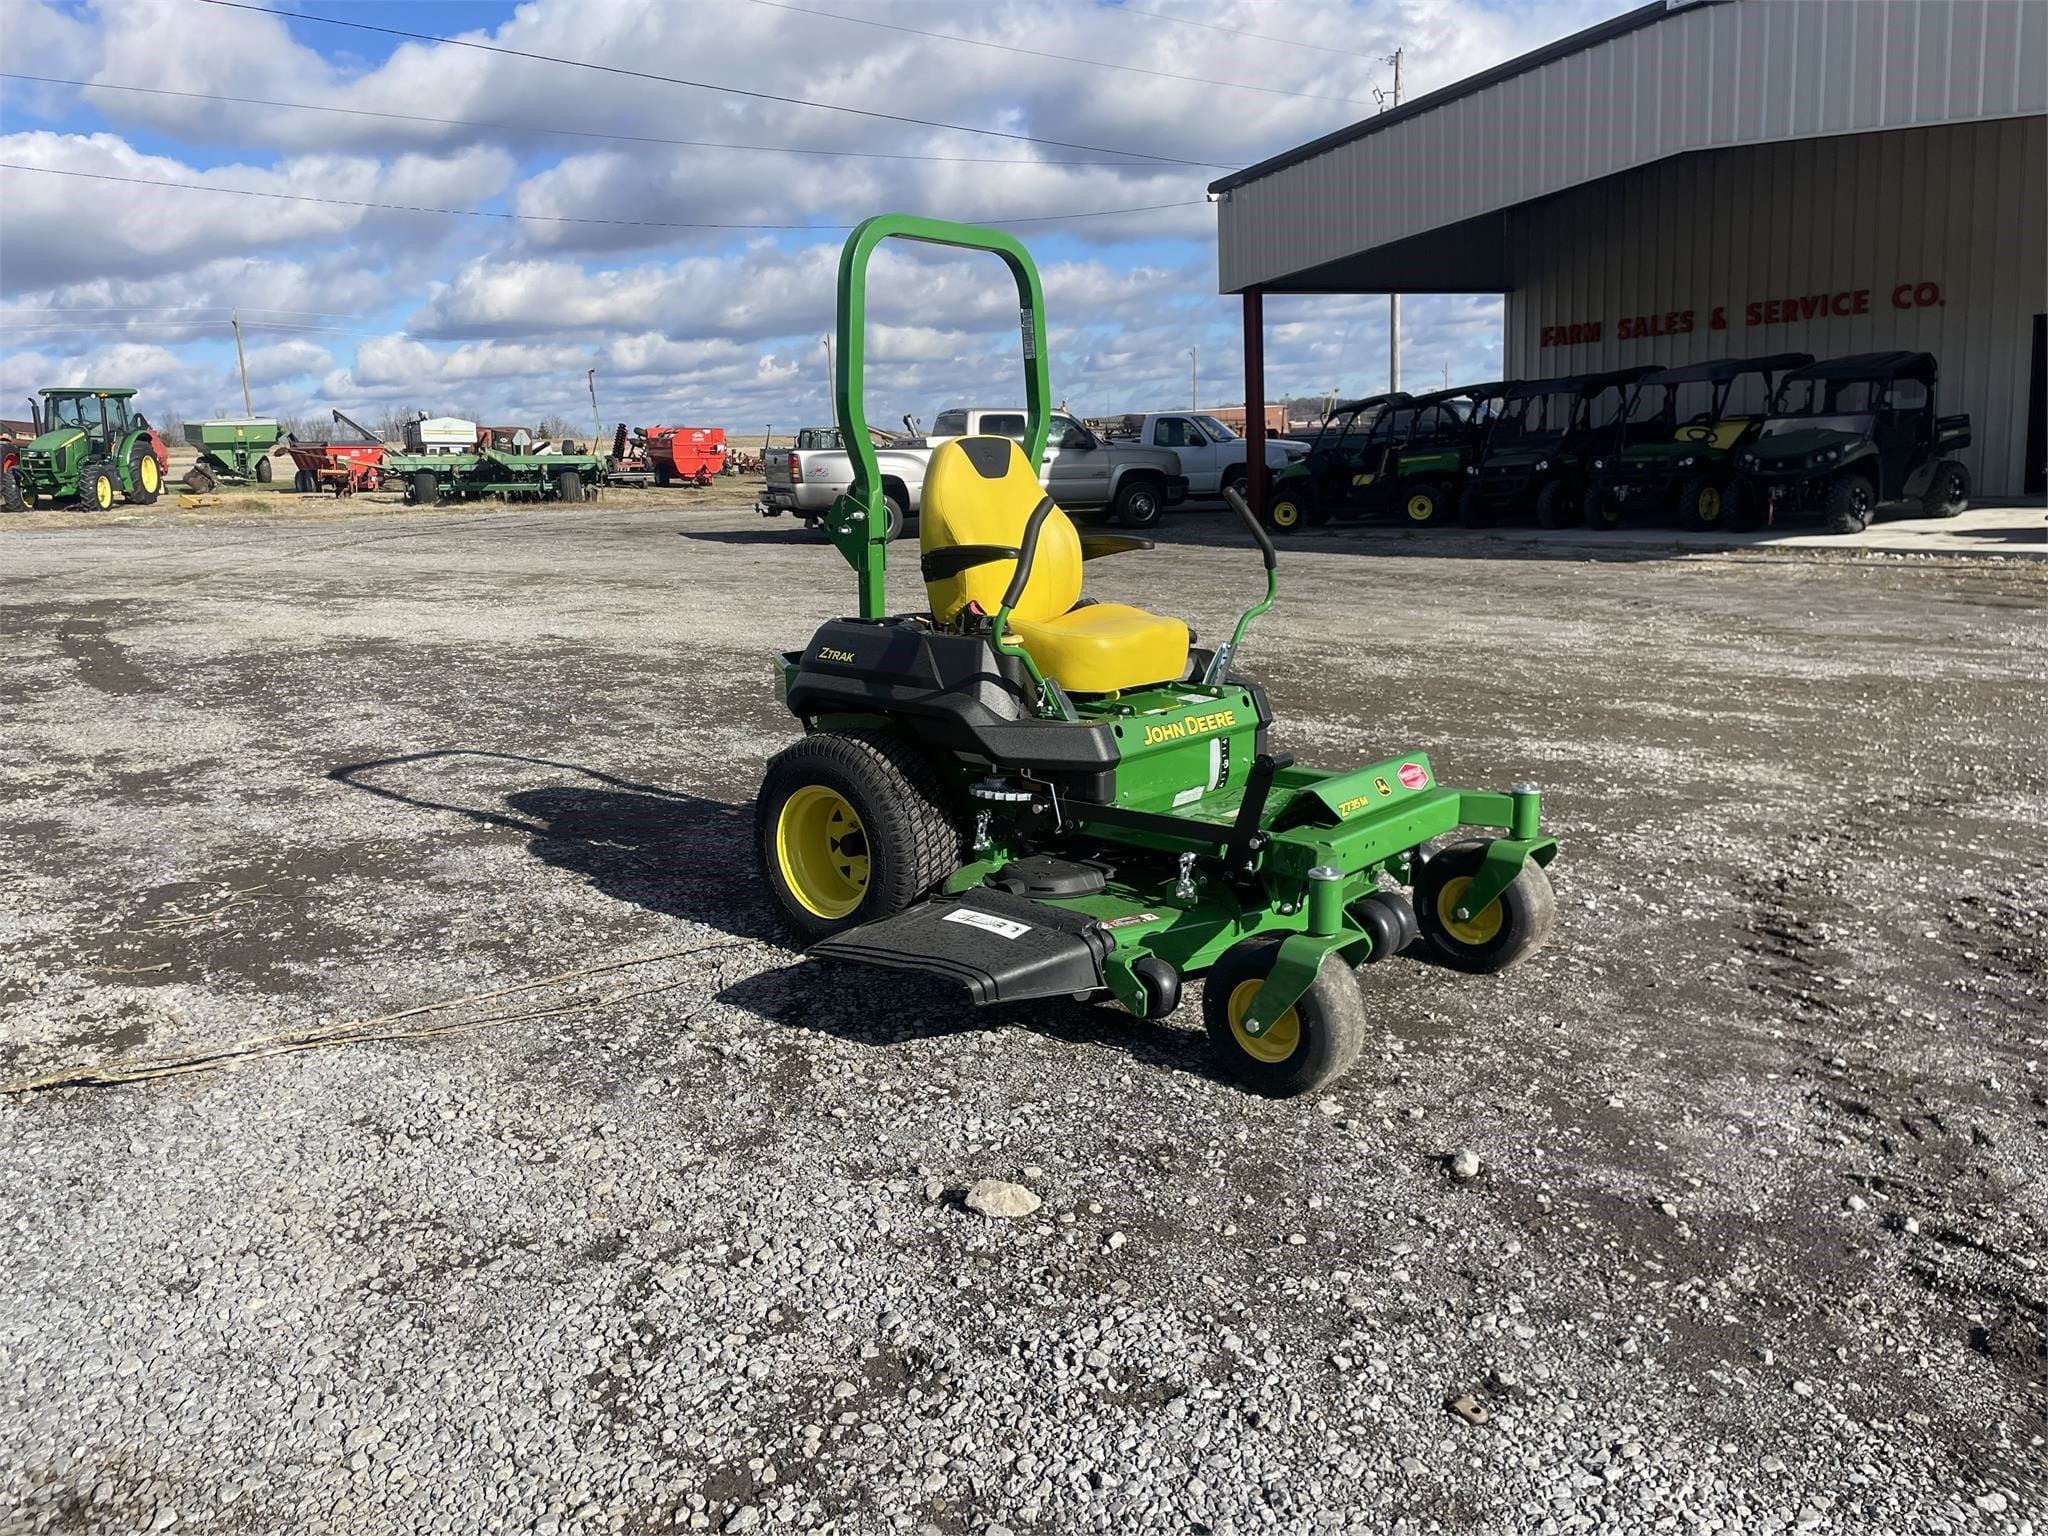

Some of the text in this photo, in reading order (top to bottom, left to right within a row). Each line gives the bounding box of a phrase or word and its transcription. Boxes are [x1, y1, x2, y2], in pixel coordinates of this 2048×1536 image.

[1540, 282, 1946, 347] FARM SALES & SERVICE CO.
[818, 647, 855, 663] ZTRAK
[1143, 710, 1236, 746] JOHN DEERE
